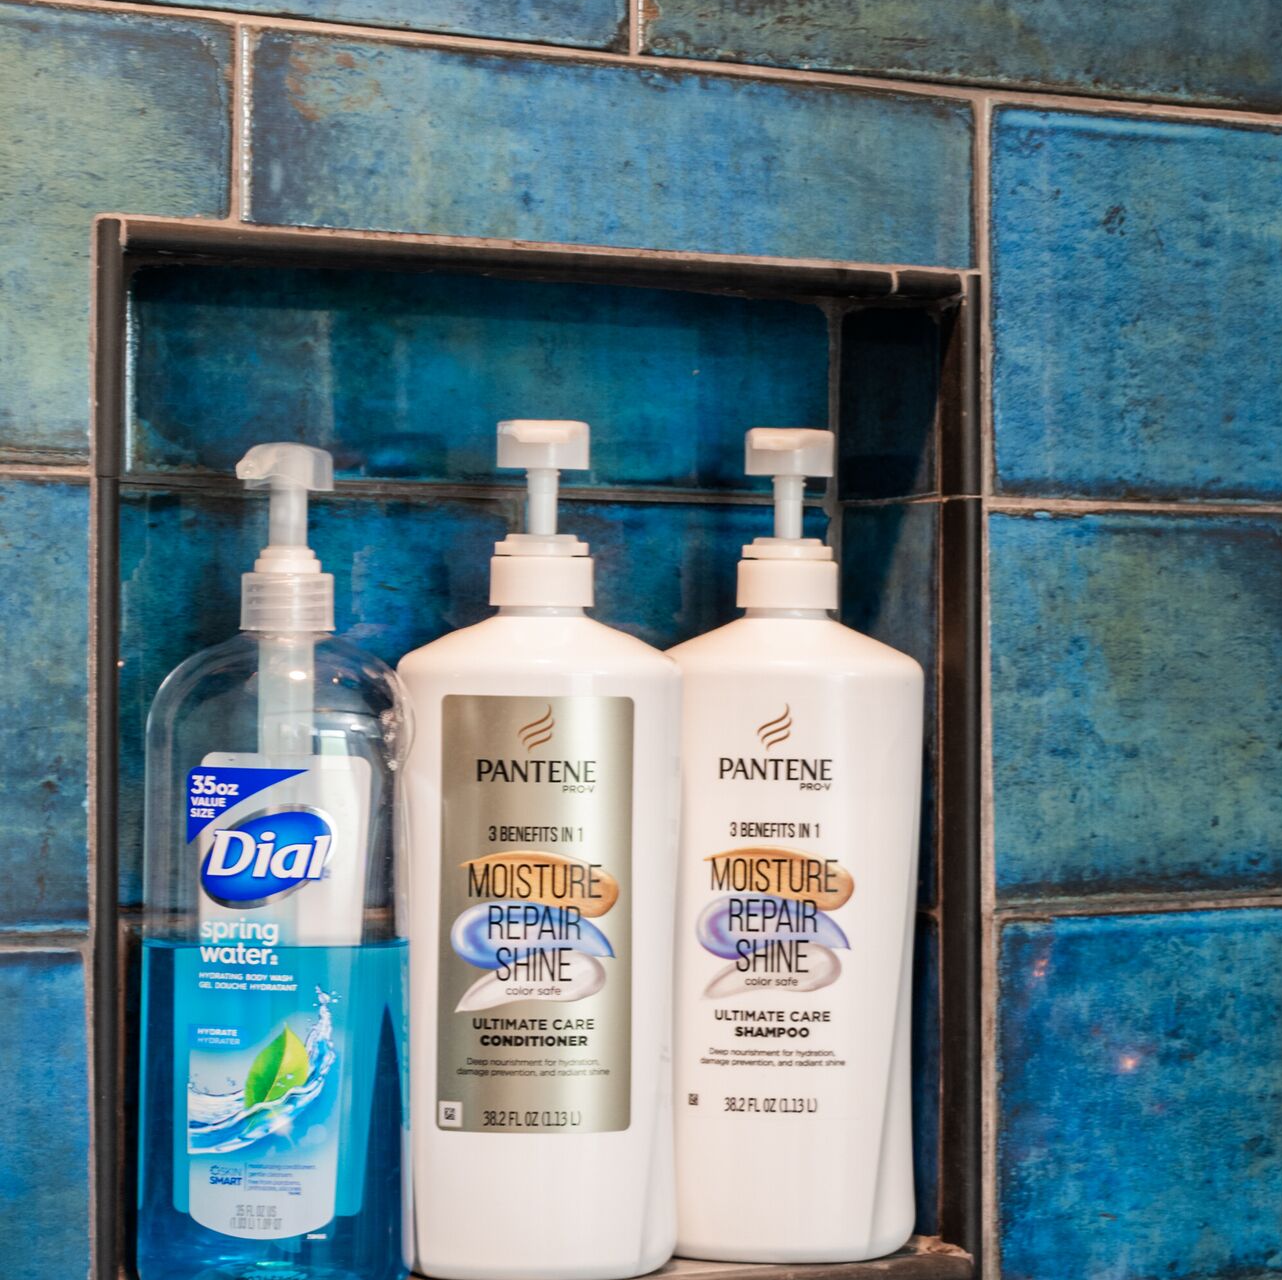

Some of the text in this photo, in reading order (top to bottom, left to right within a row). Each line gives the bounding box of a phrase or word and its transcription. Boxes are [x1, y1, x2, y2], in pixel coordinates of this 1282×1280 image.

[476, 759, 597, 783] PANTENE
[719, 758, 832, 780] PANTENE
[190, 774, 239, 796] 35oz
[562, 785, 595, 793] PRO-V
[800, 783, 831, 791] PRO-V
[190, 796, 226, 807] VALUE
[190, 808, 215, 818] SIZE
[489, 825, 583, 842] 3 BENEFITS IN 1
[730, 822, 820, 838] 3 BENEFITS IN 1
[206, 830, 331, 879] Dial
[468, 863, 602, 898] MOISTURE
[711, 857, 838, 892] MOISTURE
[729, 899, 818, 933] REPAIR
[488, 905, 581, 940] REPAIR
[200, 917, 279, 946] spring
[736, 939, 809, 973] SHINE
[496, 947, 573, 982] SHINE
[199, 972, 243, 980] HYDRATING
[745, 977, 798, 986] color safe
[215, 982, 247, 990] DOUCHE
[506, 986, 562, 996] color safe
[715, 1009, 831, 1022] ULTIMATE CARE
[473, 1018, 594, 1031] ULTIMATE CARE
[197, 1028, 237, 1036] HYDRATE
[735, 1027, 809, 1038] SHAMPOO
[197, 1037, 240, 1045] HYDRATER
[480, 1035, 588, 1046] CONDITIONER
[709, 1048, 728, 1056] Deep
[730, 1049, 780, 1057] nourishment
[466, 1058, 488, 1066] Deep
[490, 1058, 542, 1066] nourishment
[700, 1057, 729, 1066] damage
[456, 1068, 489, 1077] damage
[724, 1097, 817, 1113] 38.2 FL OZ (1.13 L)
[483, 1111, 581, 1126] 38.2 FL OZ (1.13 L)
[209, 1176, 242, 1185] SMART
